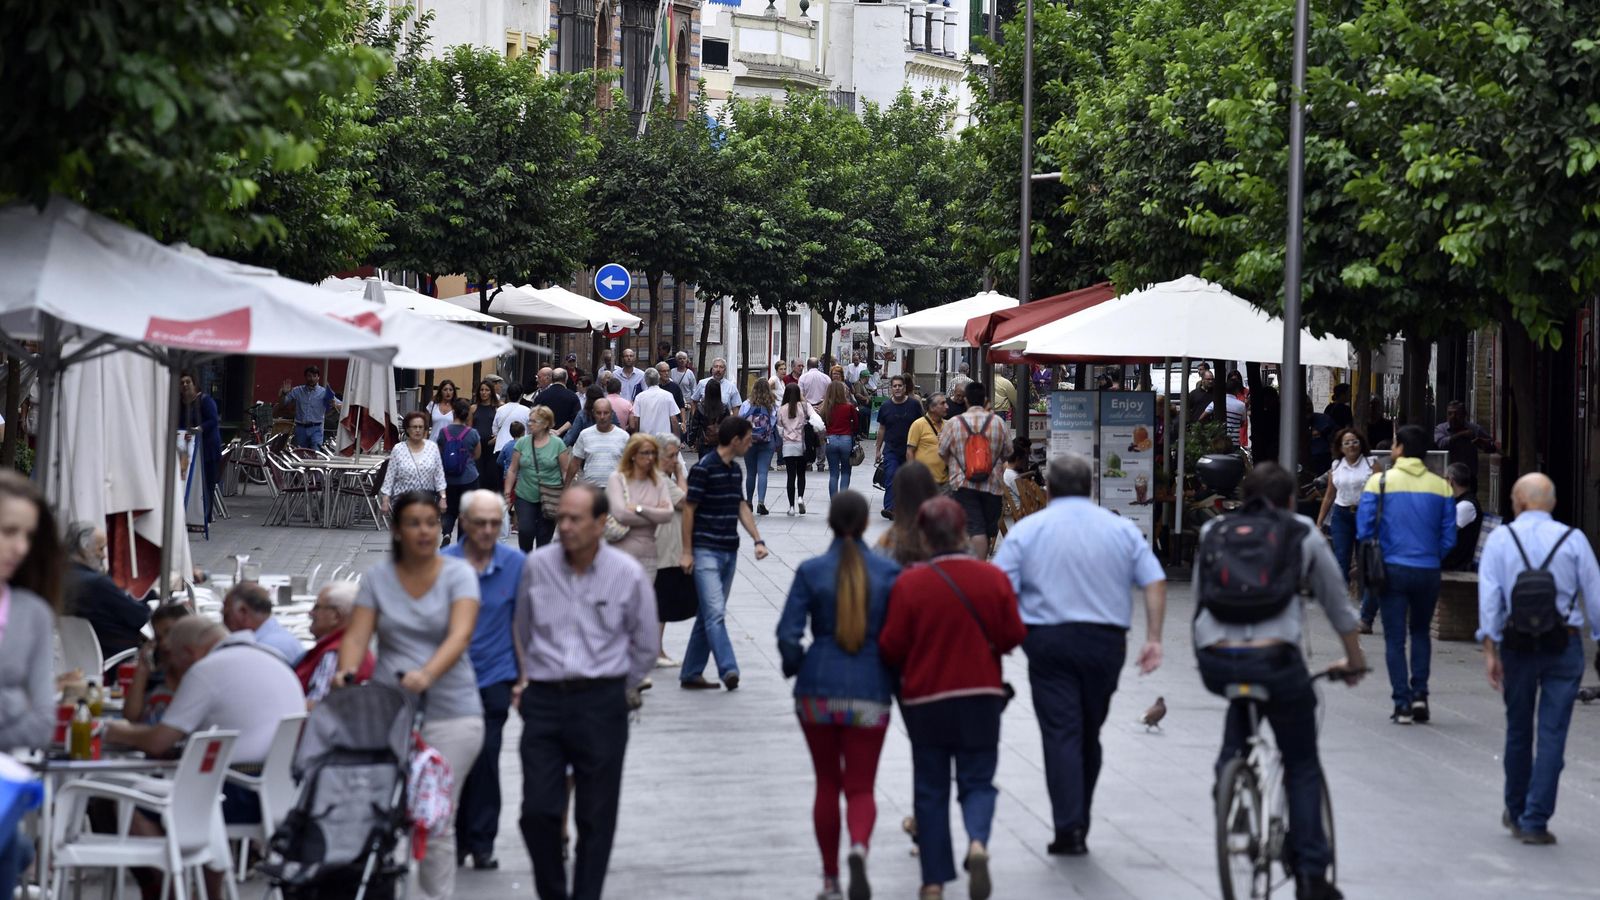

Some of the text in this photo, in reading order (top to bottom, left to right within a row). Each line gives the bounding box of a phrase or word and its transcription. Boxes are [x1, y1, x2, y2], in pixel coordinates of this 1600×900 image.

[1111, 398, 1144, 411] Enjoy
[1059, 410, 1088, 418] buenos
[1053, 418, 1092, 427] desayunos
